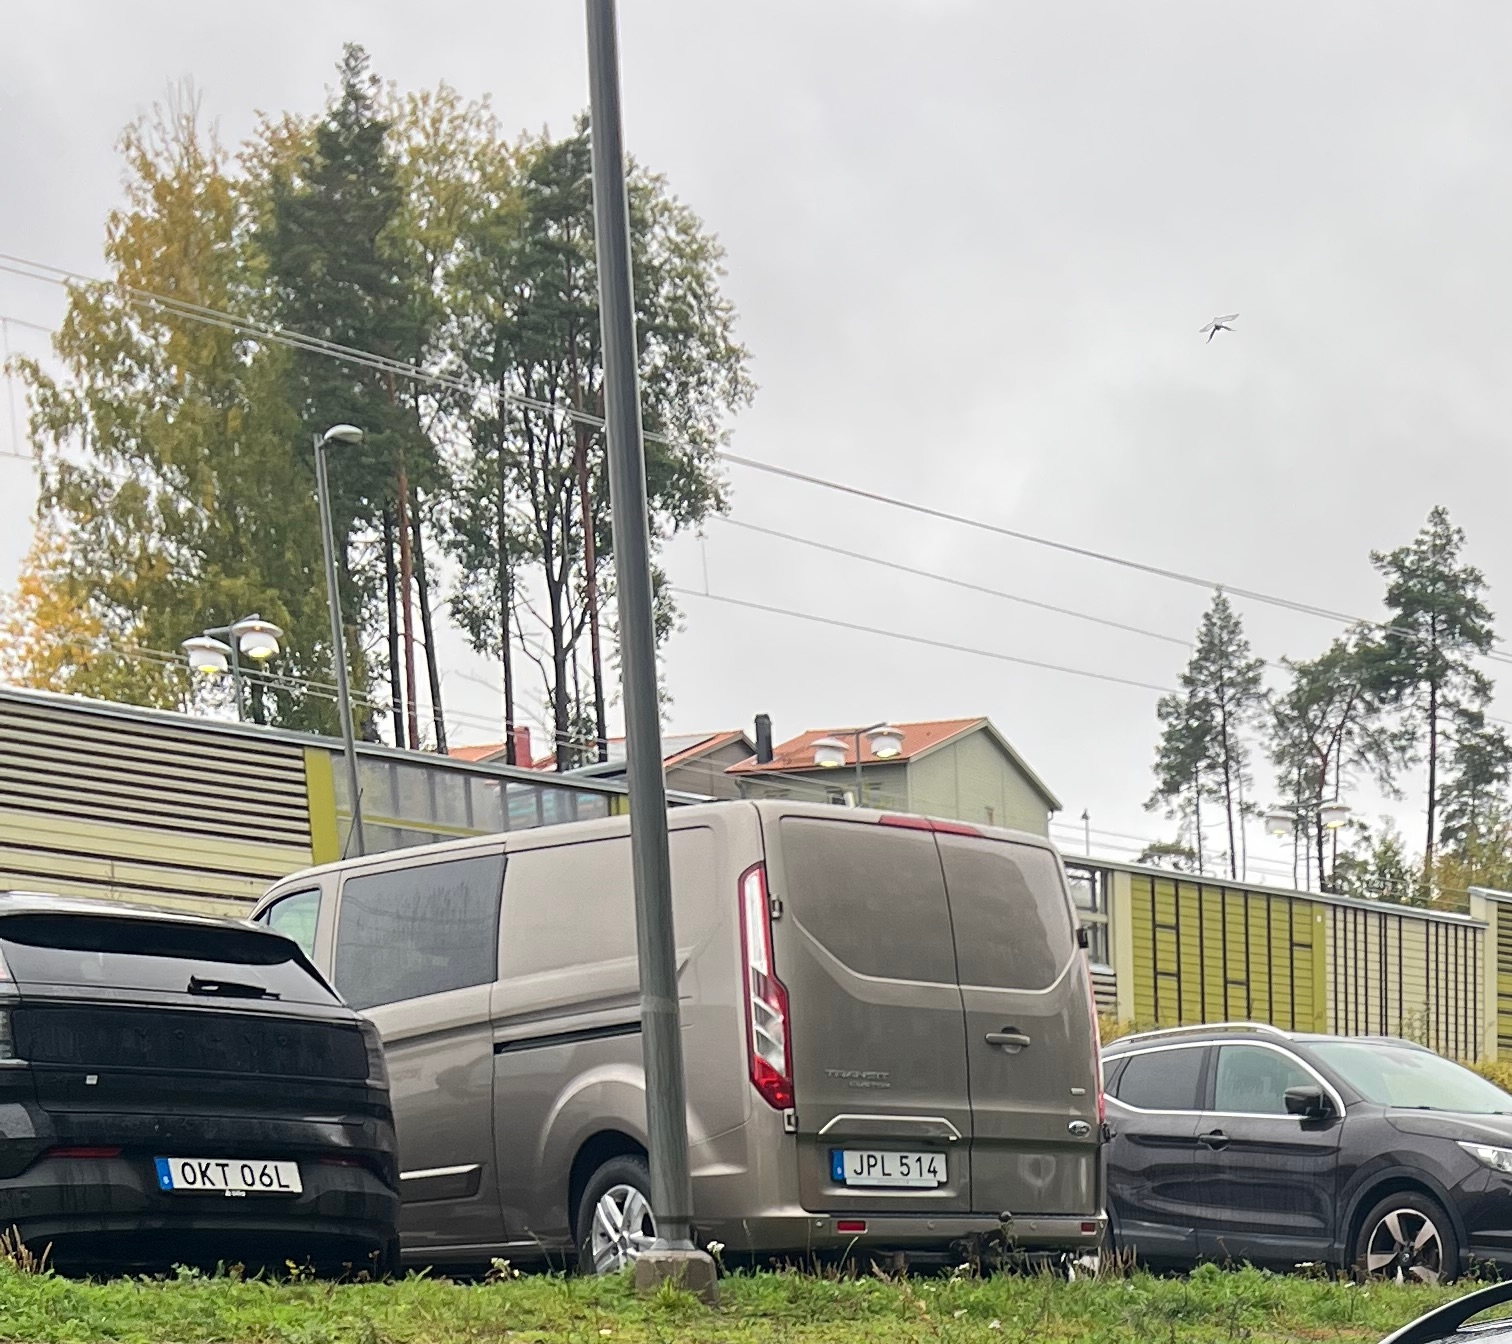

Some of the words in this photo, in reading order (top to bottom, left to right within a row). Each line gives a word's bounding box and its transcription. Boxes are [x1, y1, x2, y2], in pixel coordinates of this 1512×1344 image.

[181, 1162, 229, 1186] OKT
[240, 1164, 290, 1188] 06L
[853, 1154, 892, 1176] JPL
[899, 1155, 938, 1178] 514
